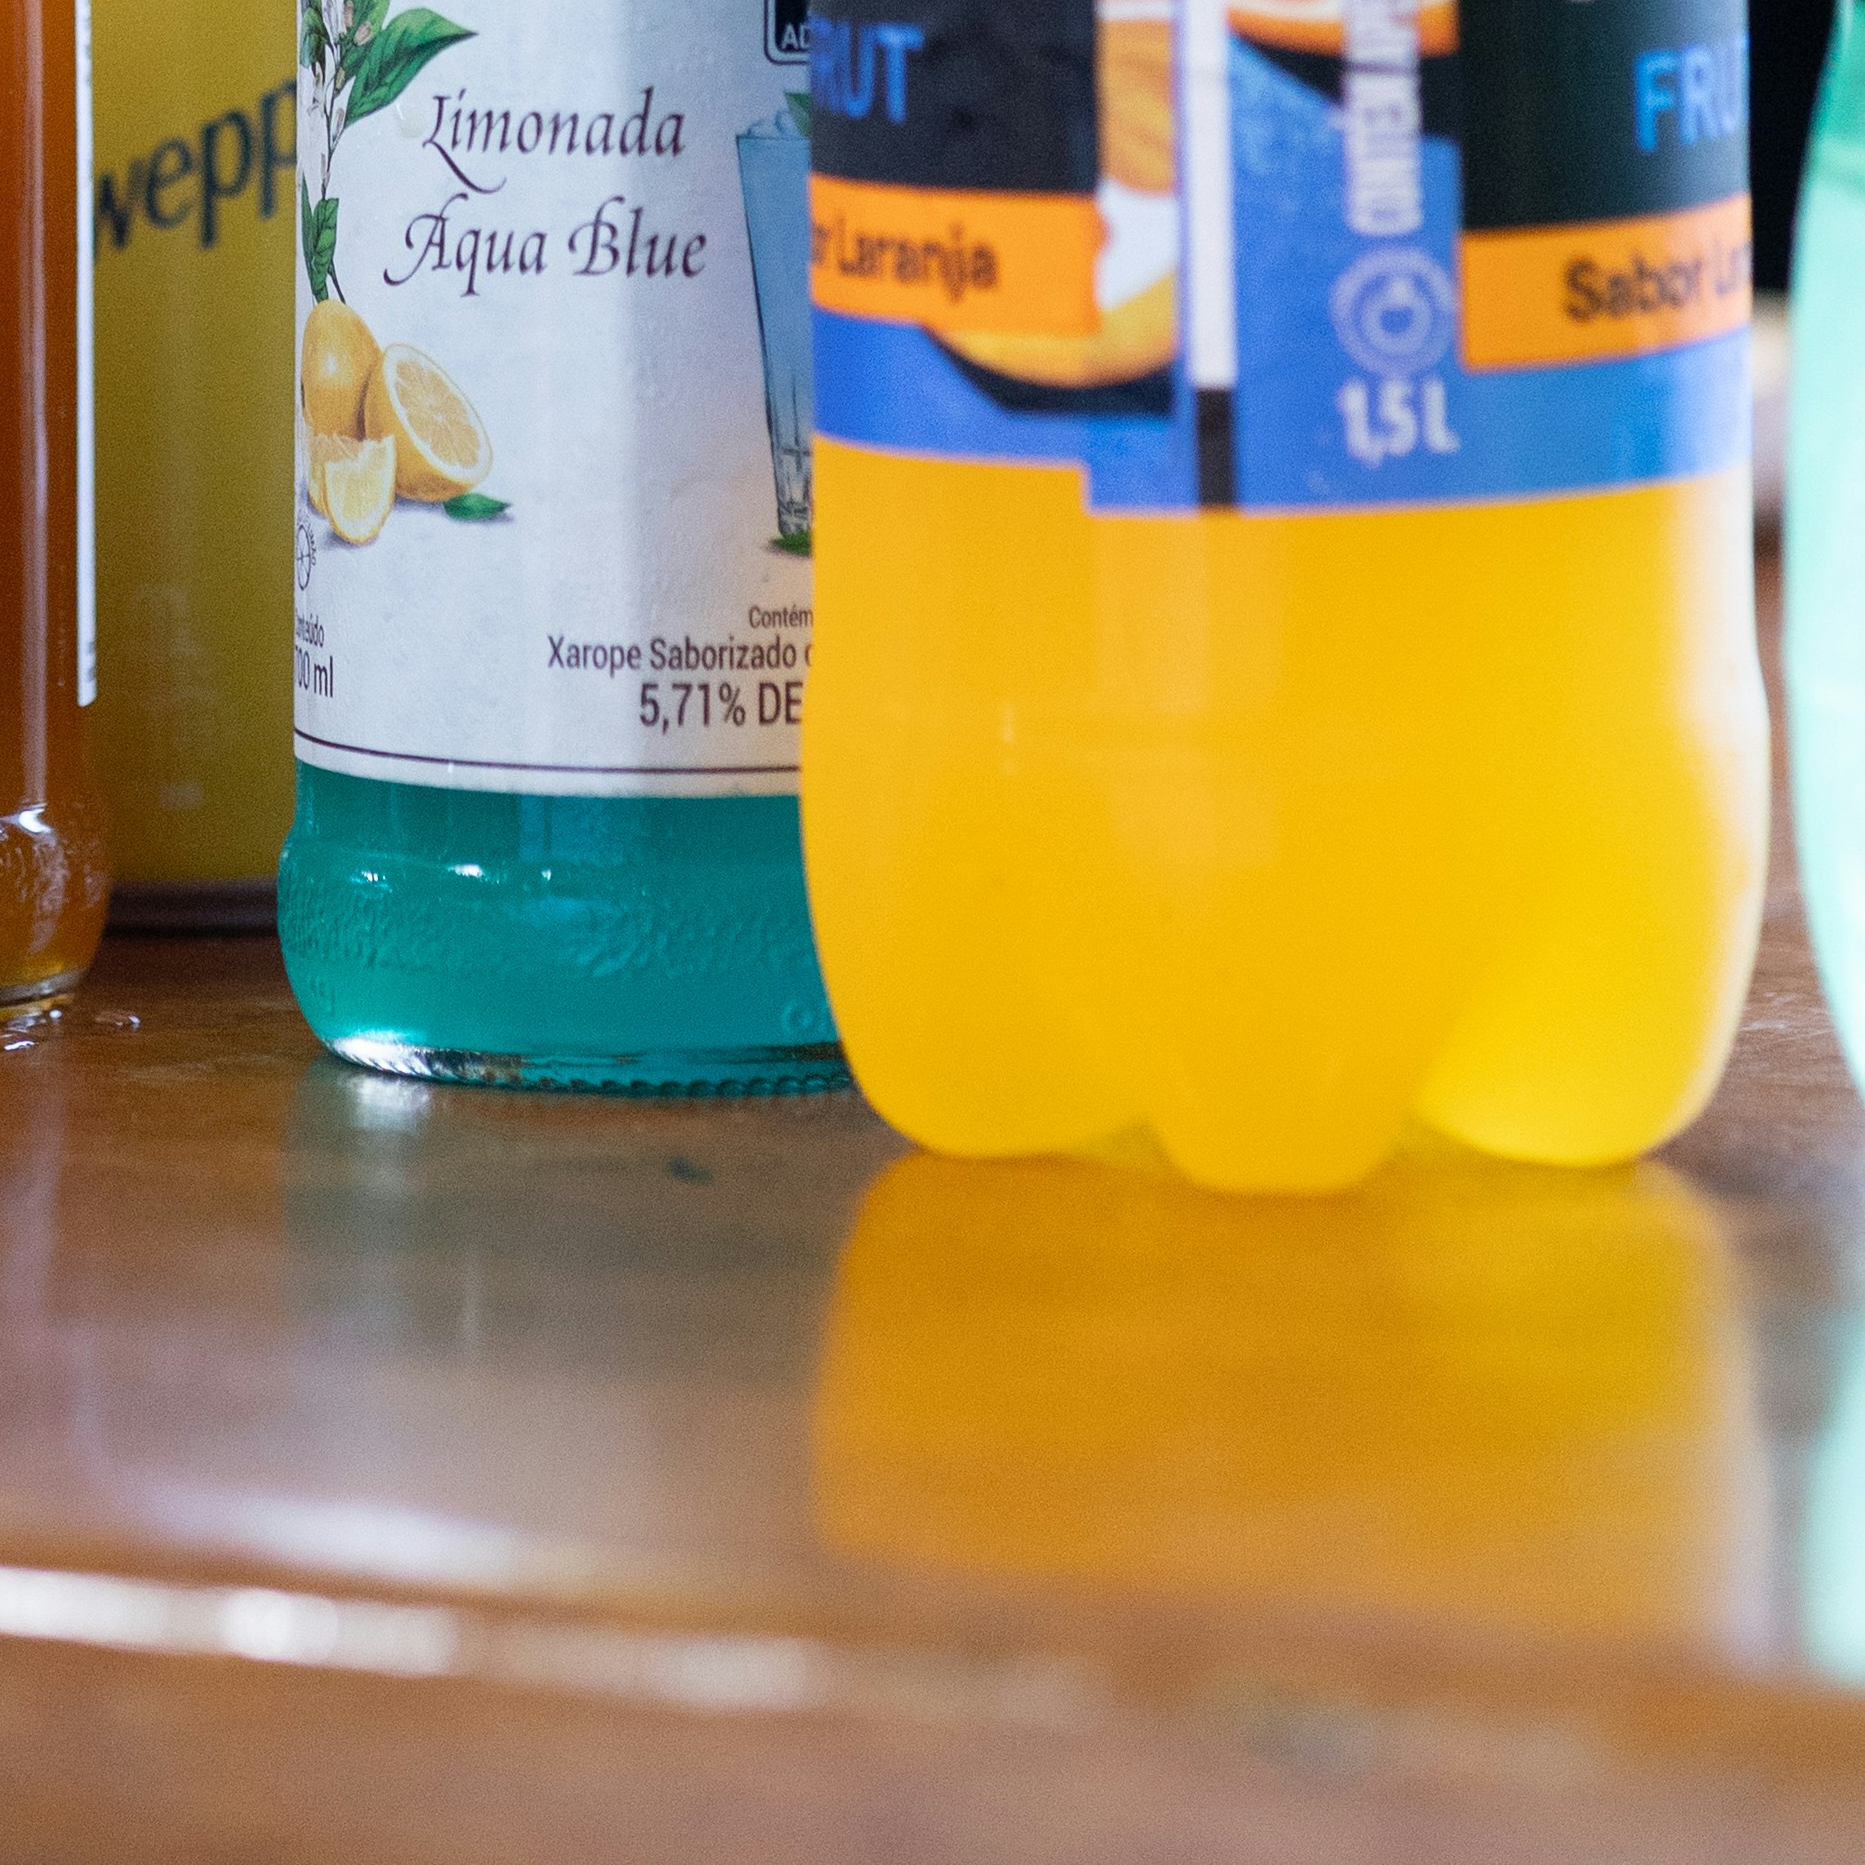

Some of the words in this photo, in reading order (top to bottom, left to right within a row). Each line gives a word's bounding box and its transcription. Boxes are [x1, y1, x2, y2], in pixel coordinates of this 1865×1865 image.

[809, 13, 924, 125] RUT
[1637, 35, 1750, 153] FRU
[422, 85, 687, 195] Limonada
[383, 191, 549, 299] Aqua
[567, 196, 708, 279] Blue
[1562, 251, 1701, 326] Sabor
[748, 605, 814, 630] Contém
[313, 655, 334, 698] ml
[547, 635, 642, 678] Xarope
[649, 634, 797, 671] Saborizado
[639, 681, 746, 736] 5,71%
[758, 681, 804, 726] DE
